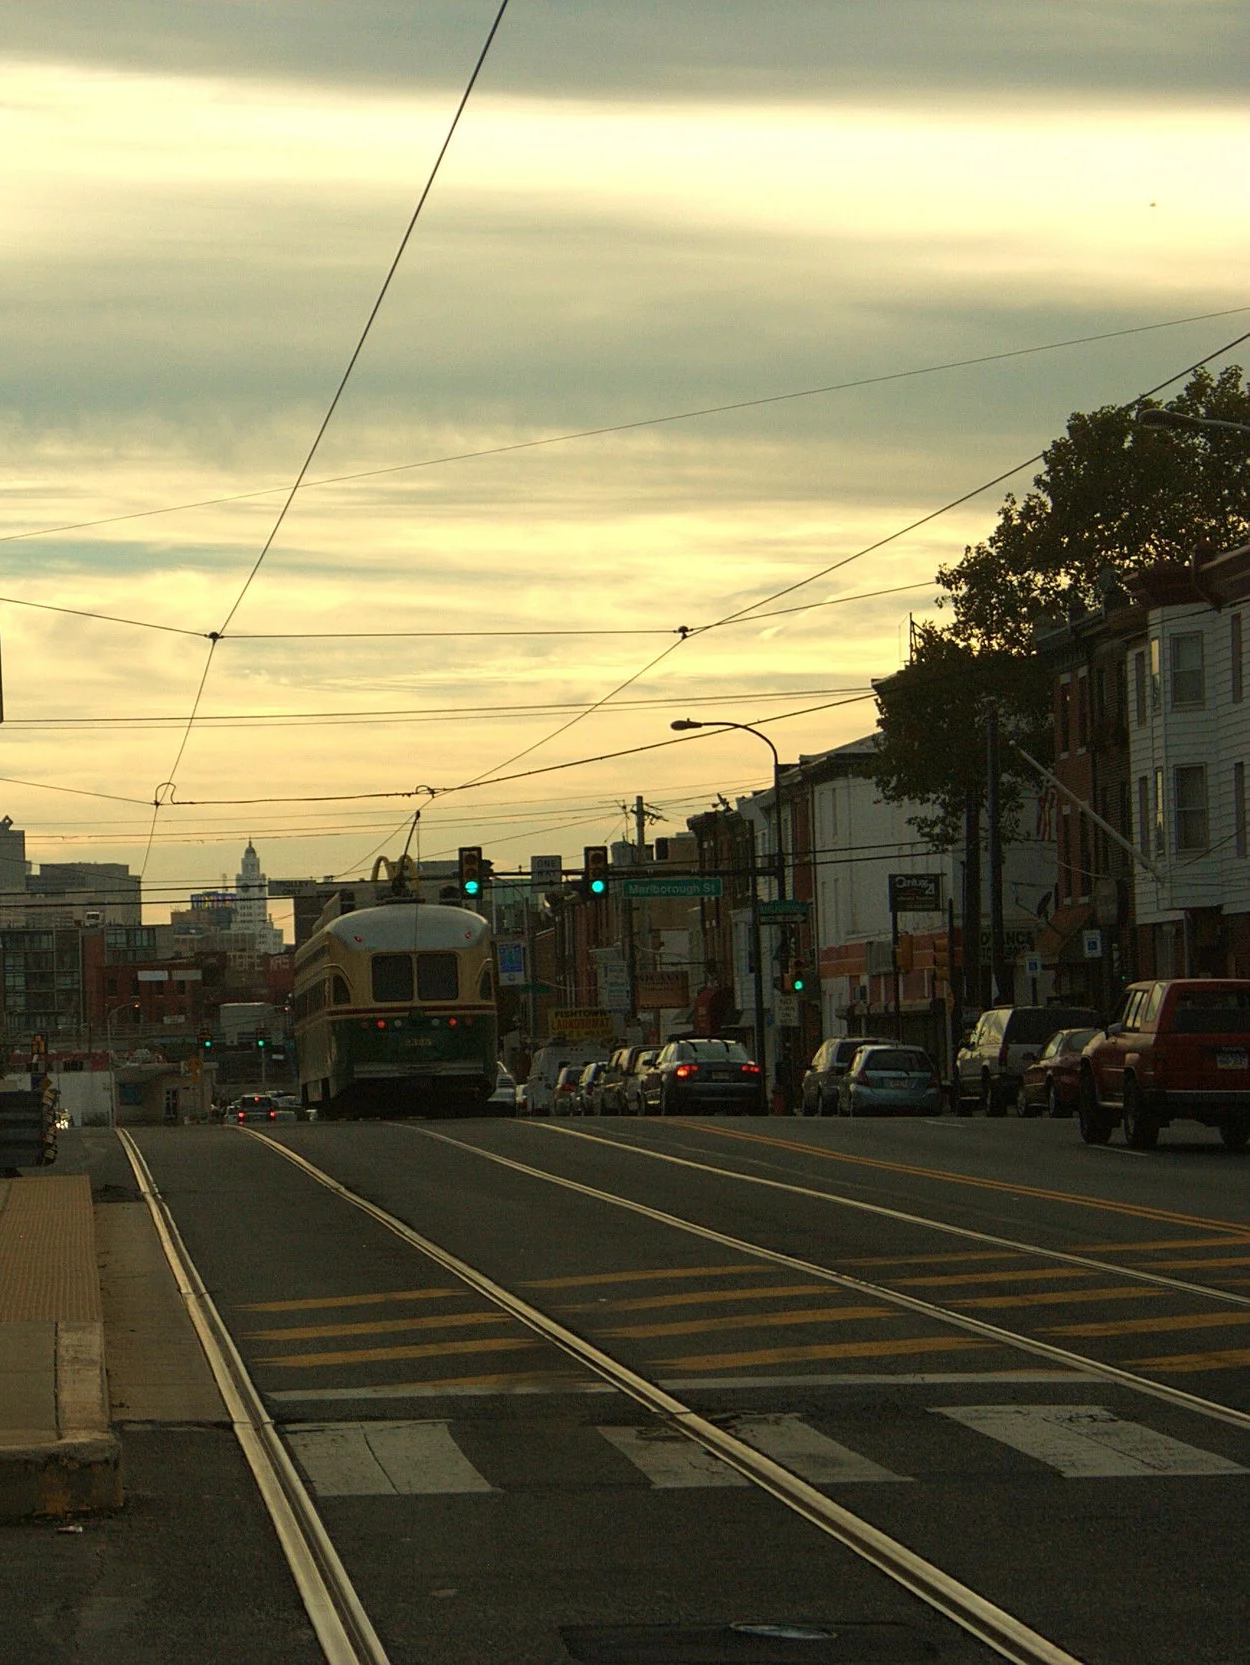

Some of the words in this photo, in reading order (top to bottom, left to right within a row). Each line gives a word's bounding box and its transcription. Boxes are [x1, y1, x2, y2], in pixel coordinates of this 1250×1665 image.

[536, 859, 558, 869] ONE
[275, 880, 310, 888] TROLLEY
[629, 883, 701, 896] Marlborough
[702, 881, 716, 893] St
[281, 888, 304, 896] ONLY
[554, 1009, 608, 1018] FISHTOWN
